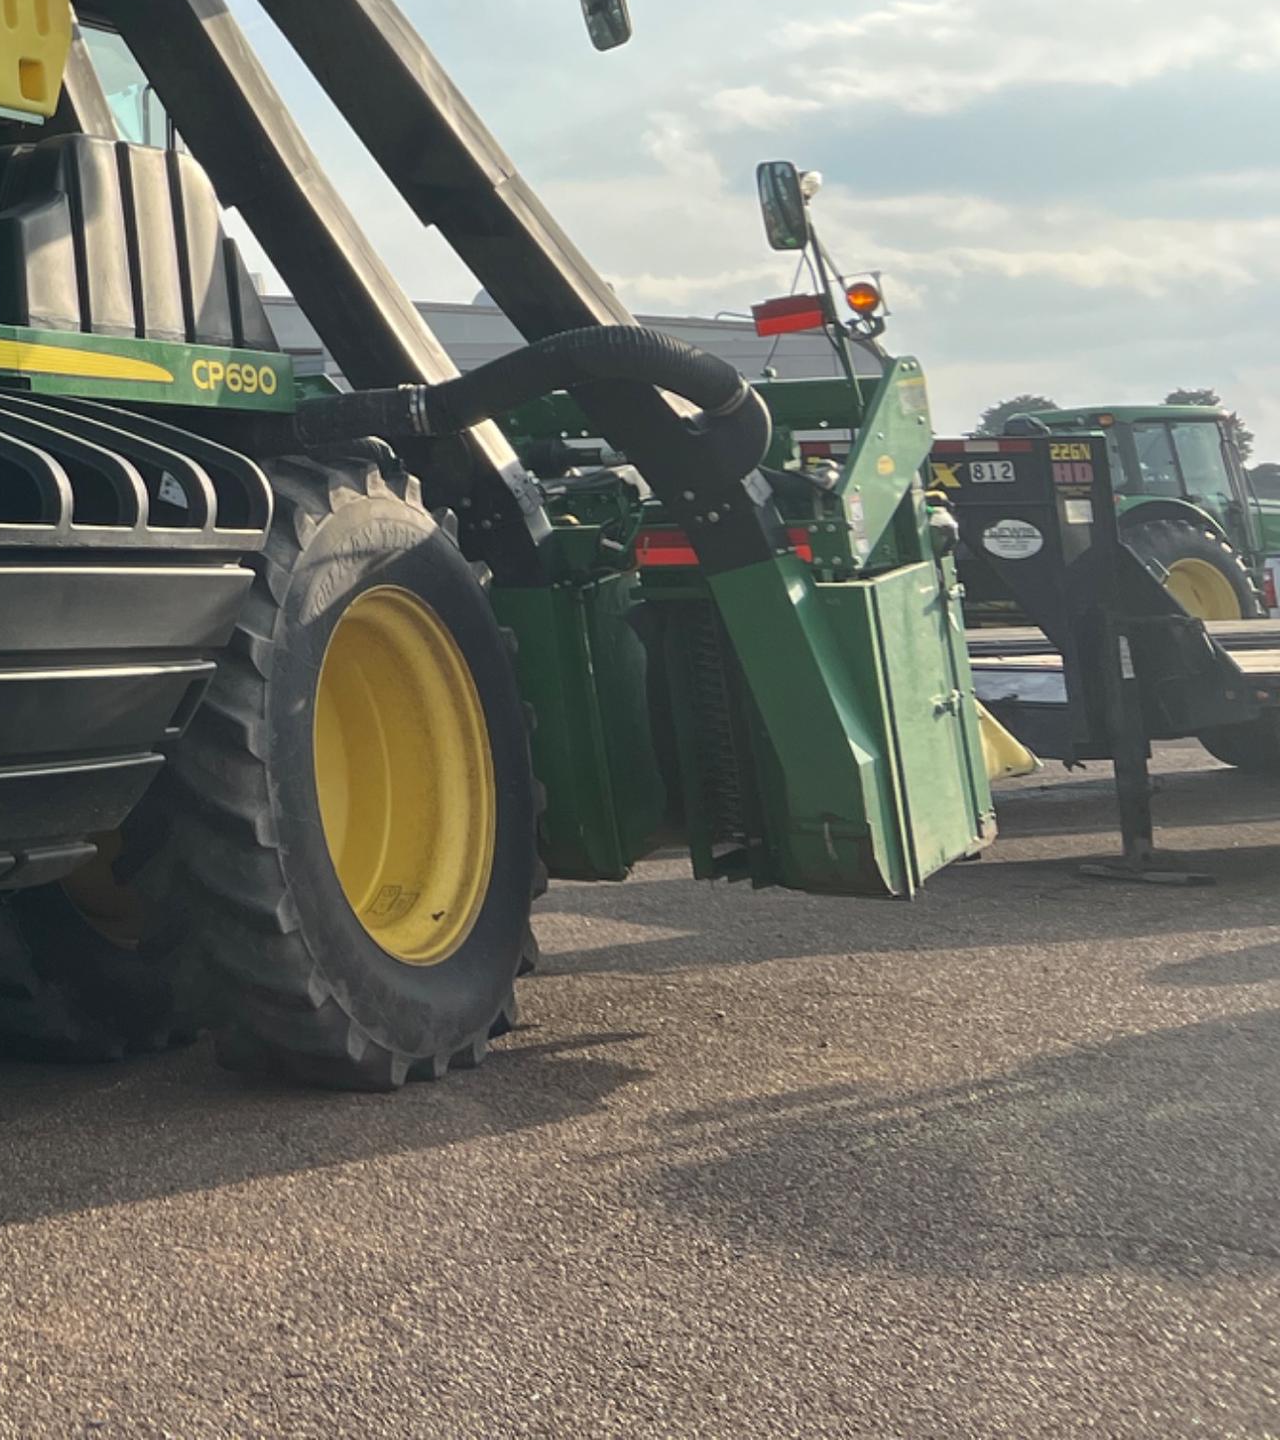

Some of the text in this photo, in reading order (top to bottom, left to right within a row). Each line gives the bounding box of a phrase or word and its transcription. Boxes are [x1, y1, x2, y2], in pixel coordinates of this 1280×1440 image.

[191, 359, 278, 396] CP690
[973, 463, 1012, 481] 812
[1052, 462, 1094, 483] HD
